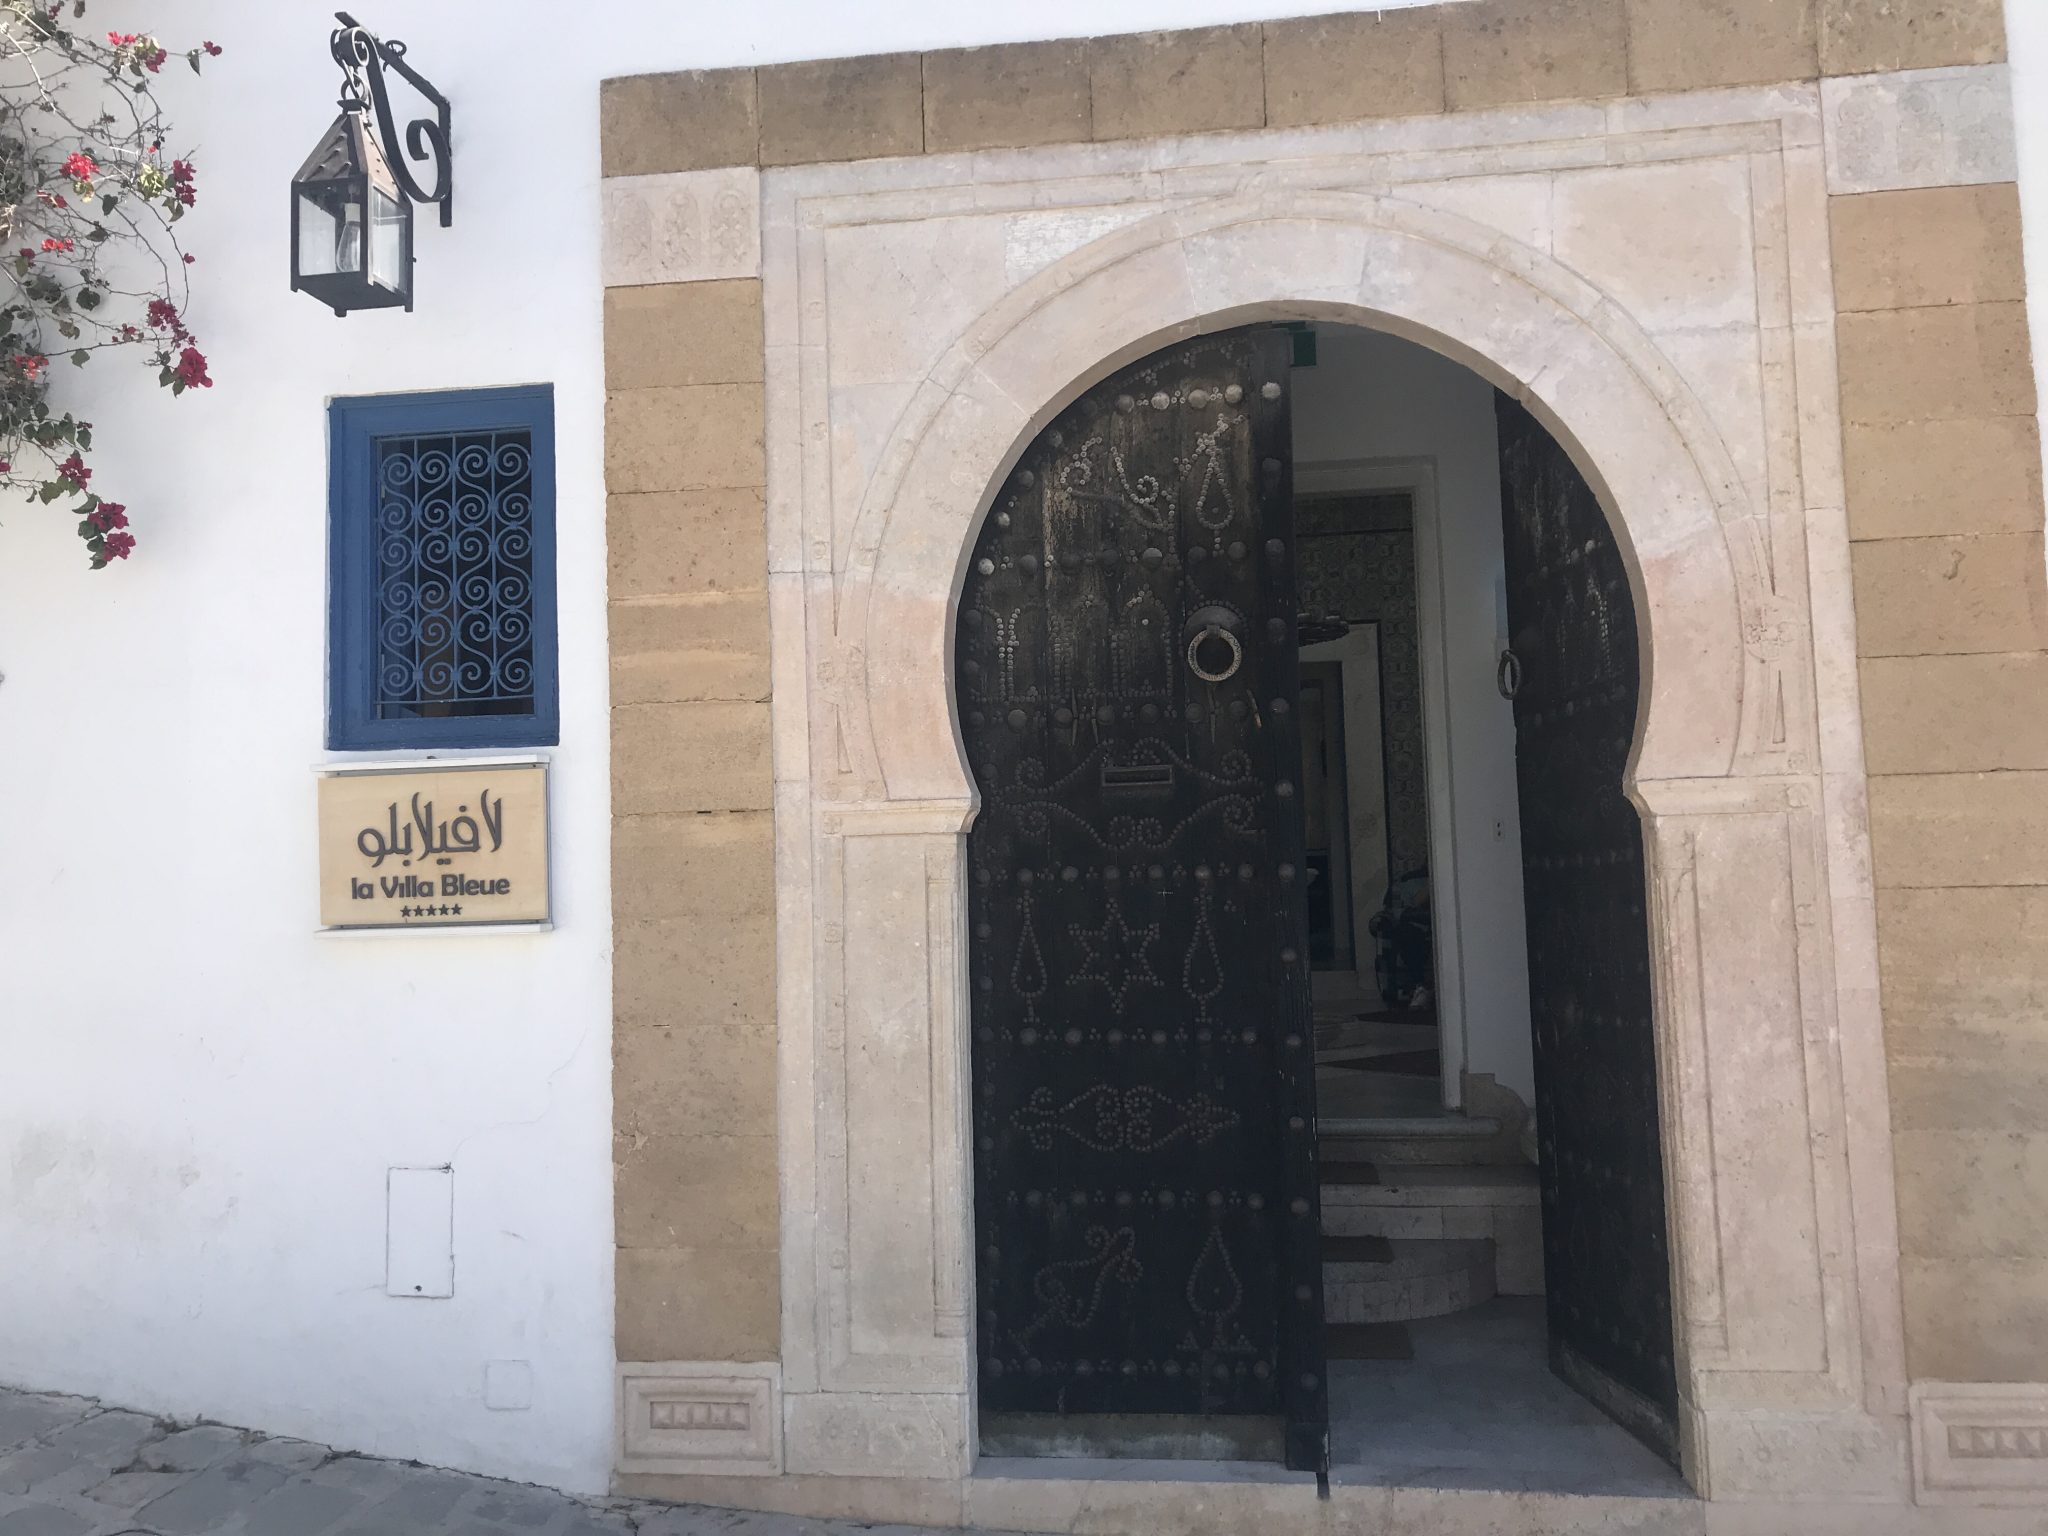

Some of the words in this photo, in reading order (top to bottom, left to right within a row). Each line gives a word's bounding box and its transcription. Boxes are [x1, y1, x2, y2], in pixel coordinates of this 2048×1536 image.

[351, 877, 374, 900] la
[380, 876, 434, 899] Villa
[441, 874, 511, 897] Bleue
